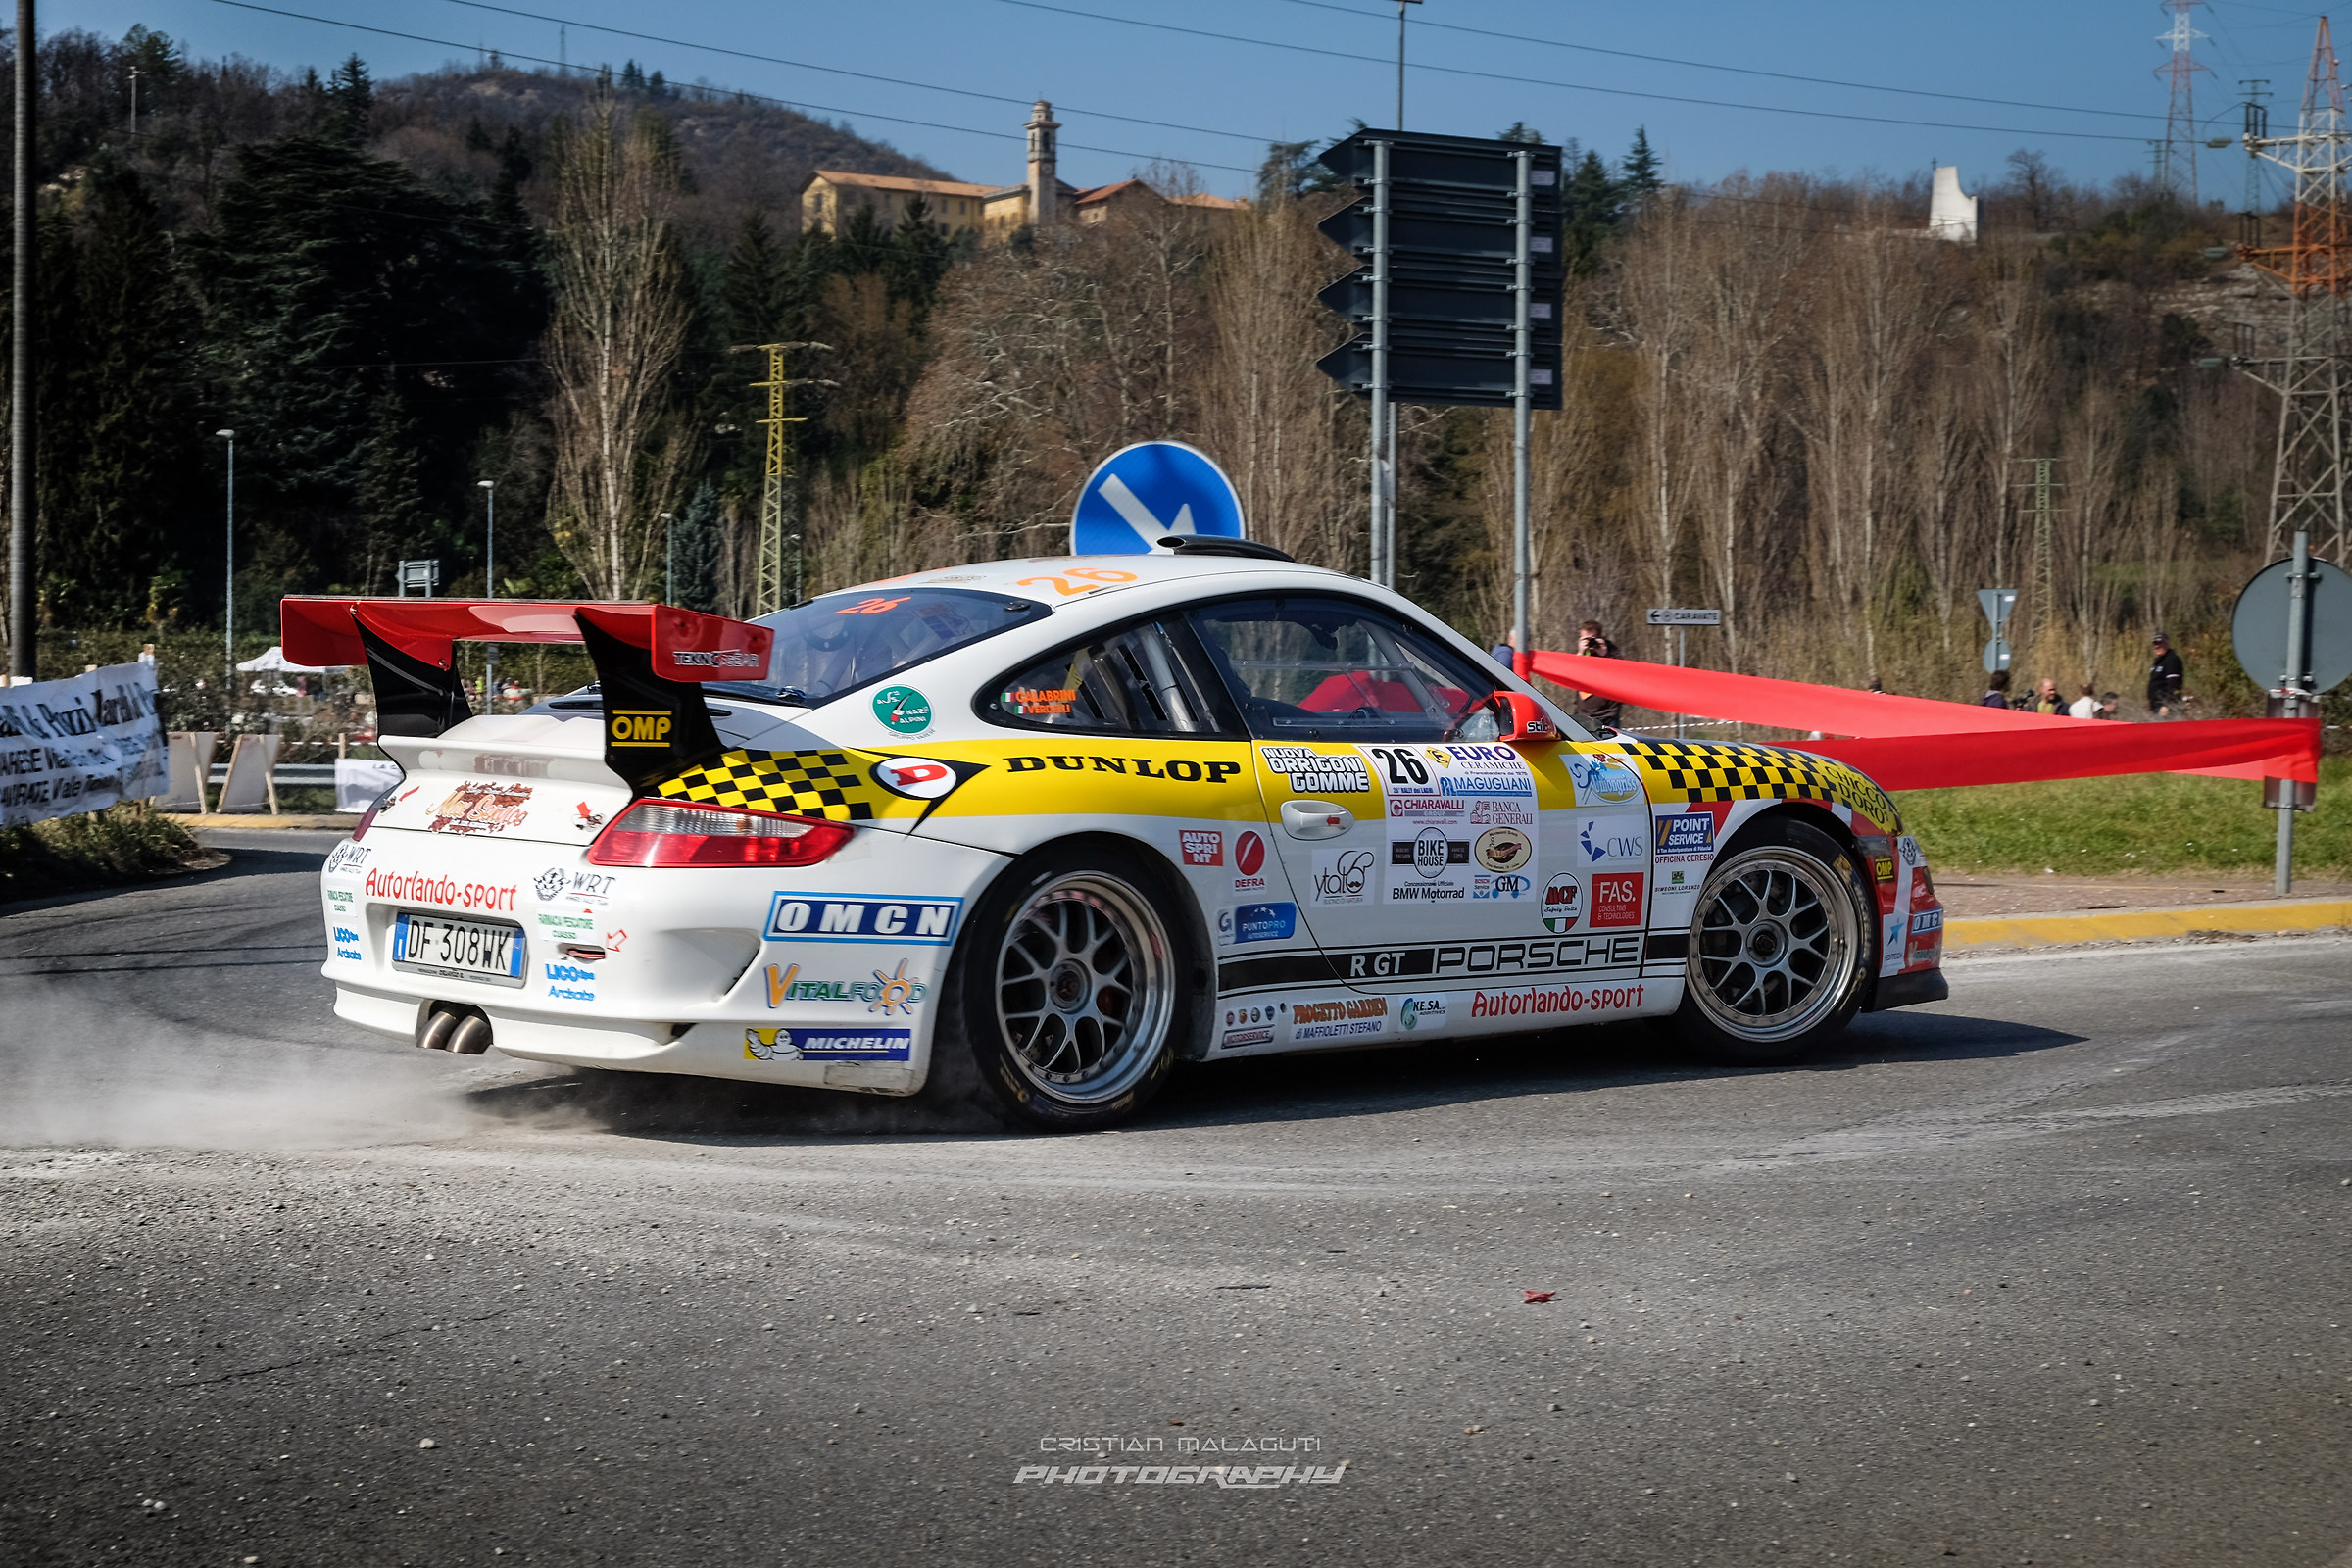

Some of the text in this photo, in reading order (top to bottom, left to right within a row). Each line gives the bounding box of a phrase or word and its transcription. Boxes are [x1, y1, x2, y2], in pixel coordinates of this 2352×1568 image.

[1016, 567, 1137, 596] 26
[834, 597, 911, 615] 26
[612, 716, 672, 740] OMP
[1261, 748, 1316, 758] NUOVA
[1446, 746, 1516, 760] EURO
[1004, 755, 1241, 783] DUNLOP
[1268, 757, 1365, 773] ORRIGONI
[1372, 748, 1429, 784] 26
[1461, 761, 1525, 770] CERAMICHE
[1291, 772, 1370, 793] GOMME
[1454, 777, 1532, 790] MAGUGLIANI
[1825, 765, 1886, 809] CHICCO
[1404, 800, 1464, 809] CHIARAVALLI
[1492, 802, 1521, 812] BANCA
[1492, 813, 1533, 824] GENERALI
[1673, 818, 1710, 832] POINT
[1182, 832, 1220, 843] AUTO
[1669, 833, 1704, 846] SERVICE
[346, 845, 371, 864] WRT
[1184, 843, 1217, 854] SPRI
[1418, 840, 1444, 856] BIKE
[1607, 837, 1643, 858] CWS
[1193, 853, 1212, 863] NT
[1417, 856, 1444, 866] HOUSE
[1687, 854, 1714, 862] CERESIO
[1876, 862, 1893, 875] OMP
[365, 867, 517, 911] Autorlando-sport
[573, 872, 616, 894] WRT
[1235, 878, 1265, 888] DEFRA
[1495, 876, 1520, 893] GM
[1393, 887, 1464, 900] BMW Motorrad
[1599, 881, 1636, 903] FAS.
[776, 902, 951, 935] OMCN
[1242, 920, 1286, 932] PUNTOPRO
[408, 920, 511, 971] DF 308WK
[1435, 937, 1640, 974] PORSCHE
[1350, 953, 1405, 976] R GT
[764, 962, 927, 1011] VITALFOOD
[1471, 985, 1644, 1018] Autorlando-sport
[1293, 997, 1389, 1024] PROGETTO GARDEN
[1296, 1021, 1382, 1040] di MAFFIOLETTI STEFANO
[804, 1037, 909, 1050] MICHELIN
